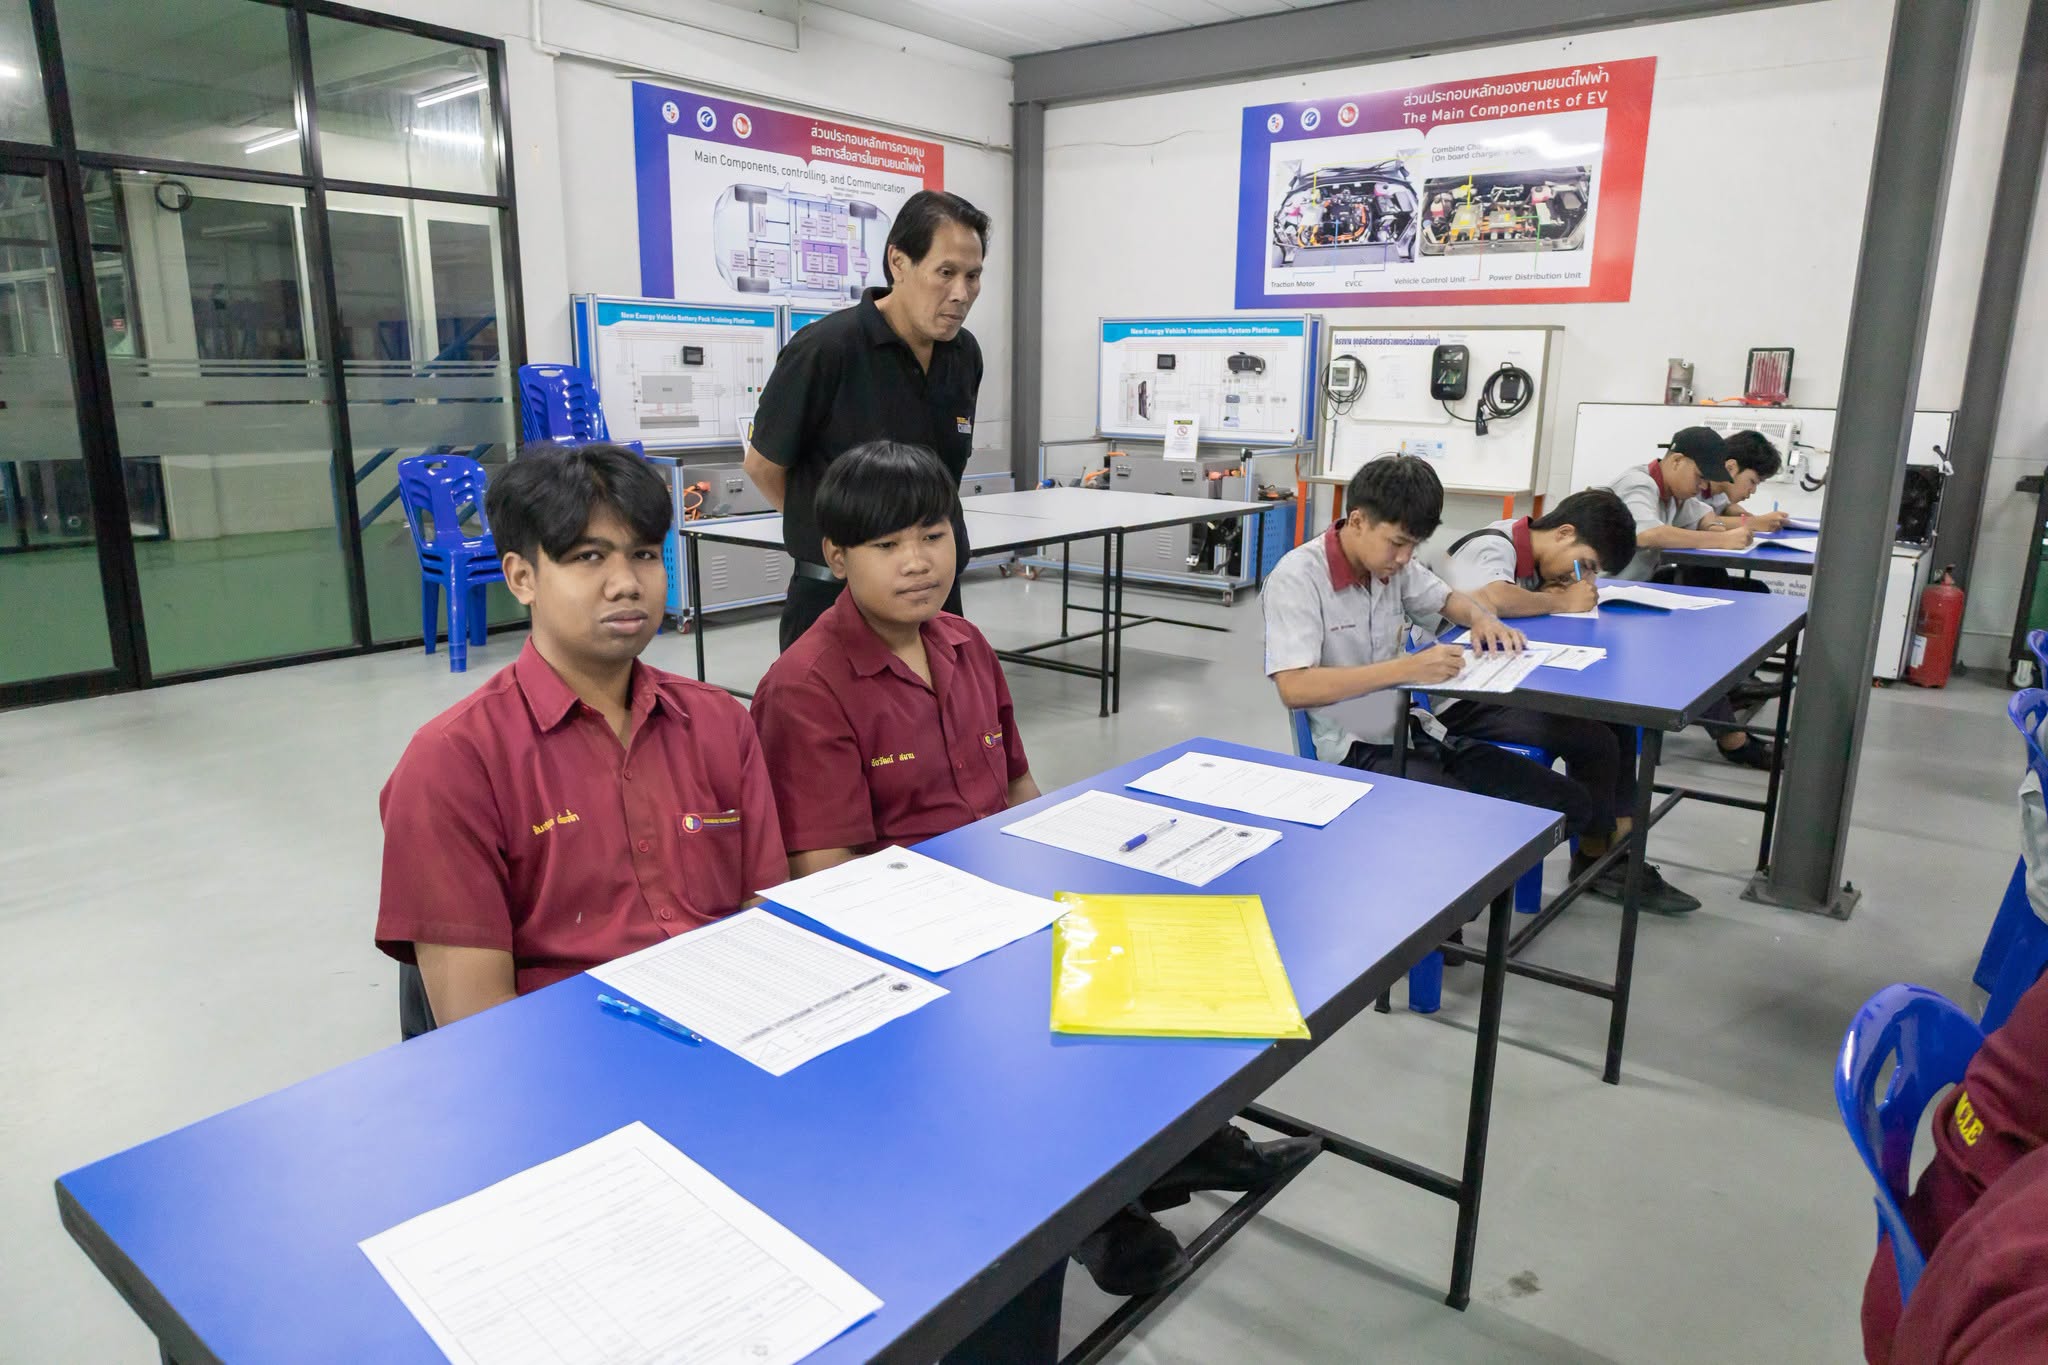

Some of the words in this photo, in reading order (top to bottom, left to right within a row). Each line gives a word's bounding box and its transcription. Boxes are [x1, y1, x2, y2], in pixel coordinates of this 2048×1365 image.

[1403, 112, 1427, 124] The
[1431, 108, 1464, 122] Main
[1469, 98, 1560, 117] Components
[1566, 93, 1581, 106] of
[1587, 90, 1608, 105] EV
[1432, 144, 1465, 154] Combine
[1447, 152, 1470, 161] board
[694, 150, 717, 164] Main
[720, 155, 779, 176] Components,
[781, 166, 828, 184] controlling,
[830, 173, 845, 184] and
[846, 176, 905, 194] Communication
[1394, 277, 1420, 285] Vehicle
[1421, 276, 1448, 285] Control
[1450, 276, 1466, 284] Unit
[1489, 274, 1512, 282] Power
[1515, 272, 1561, 281] Distribution
[1564, 272, 1582, 280] Unit
[1271, 281, 1294, 289] Traction
[1296, 280, 1315, 288] Motor
[1344, 280, 1363, 288] EVCC
[621, 311, 634, 319] New
[636, 312, 655, 320] Energy
[656, 313, 676, 321] Vehicle
[677, 314, 697, 322] Battery
[711, 316, 732, 325] Training
[1144, 327, 1164, 336] Energy
[1165, 327, 1186, 335] Vehicle
[1187, 327, 1227, 335] Transmission
[1228, 327, 1251, 336] System
[1251, 326, 1280, 334] Platform
